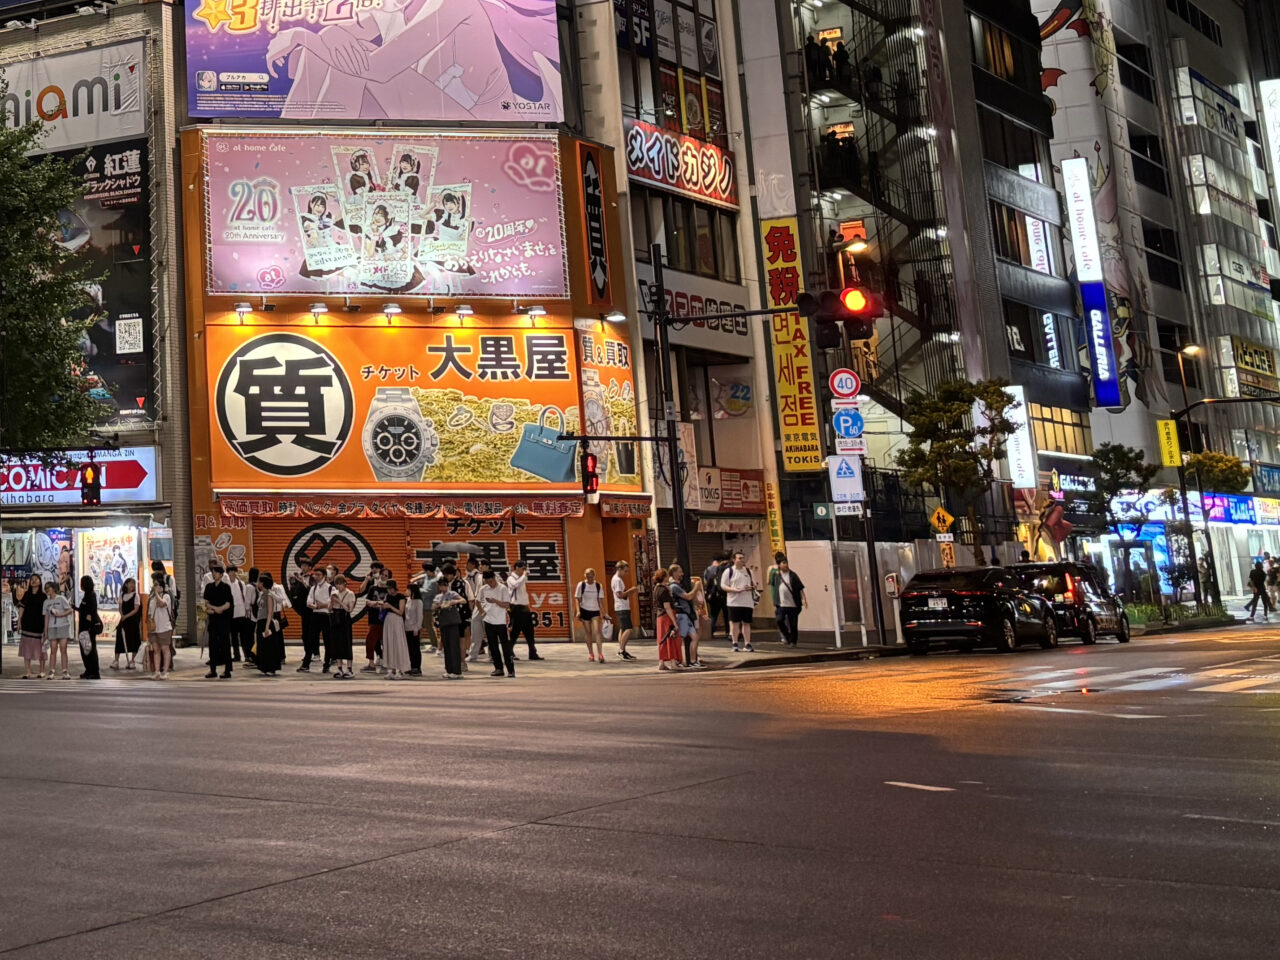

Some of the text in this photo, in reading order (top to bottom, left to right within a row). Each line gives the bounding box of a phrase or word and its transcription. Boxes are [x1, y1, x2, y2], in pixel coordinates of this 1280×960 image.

[512, 101, 551, 111] YOSTAR
[104, 149, 142, 177] 紅蓮
[627, 125, 733, 198] メイドカジノ
[229, 180, 279, 224] 20
[243, 232, 285, 241] Anniversary
[481, 262, 536, 284] これからも。
[765, 225, 800, 306] 免税
[1089, 308, 1110, 382] GALLERIA
[360, 333, 571, 382] チケット 大黒屋
[790, 312, 815, 426] TAX FREE
[836, 377, 854, 390] 40
[232, 355, 342, 459] 質
[840, 416, 853, 435] P
[784, 432, 818, 443] 東京電気
[785, 444, 819, 453] AKIHABARA
[786, 455, 820, 464] TOKIS
[0, 492, 55, 505] kihabara
[699, 487, 720, 500] TOKIS
[222, 500, 583, 515] 高価買取 無料査定
[446, 517, 527, 536] チケット
